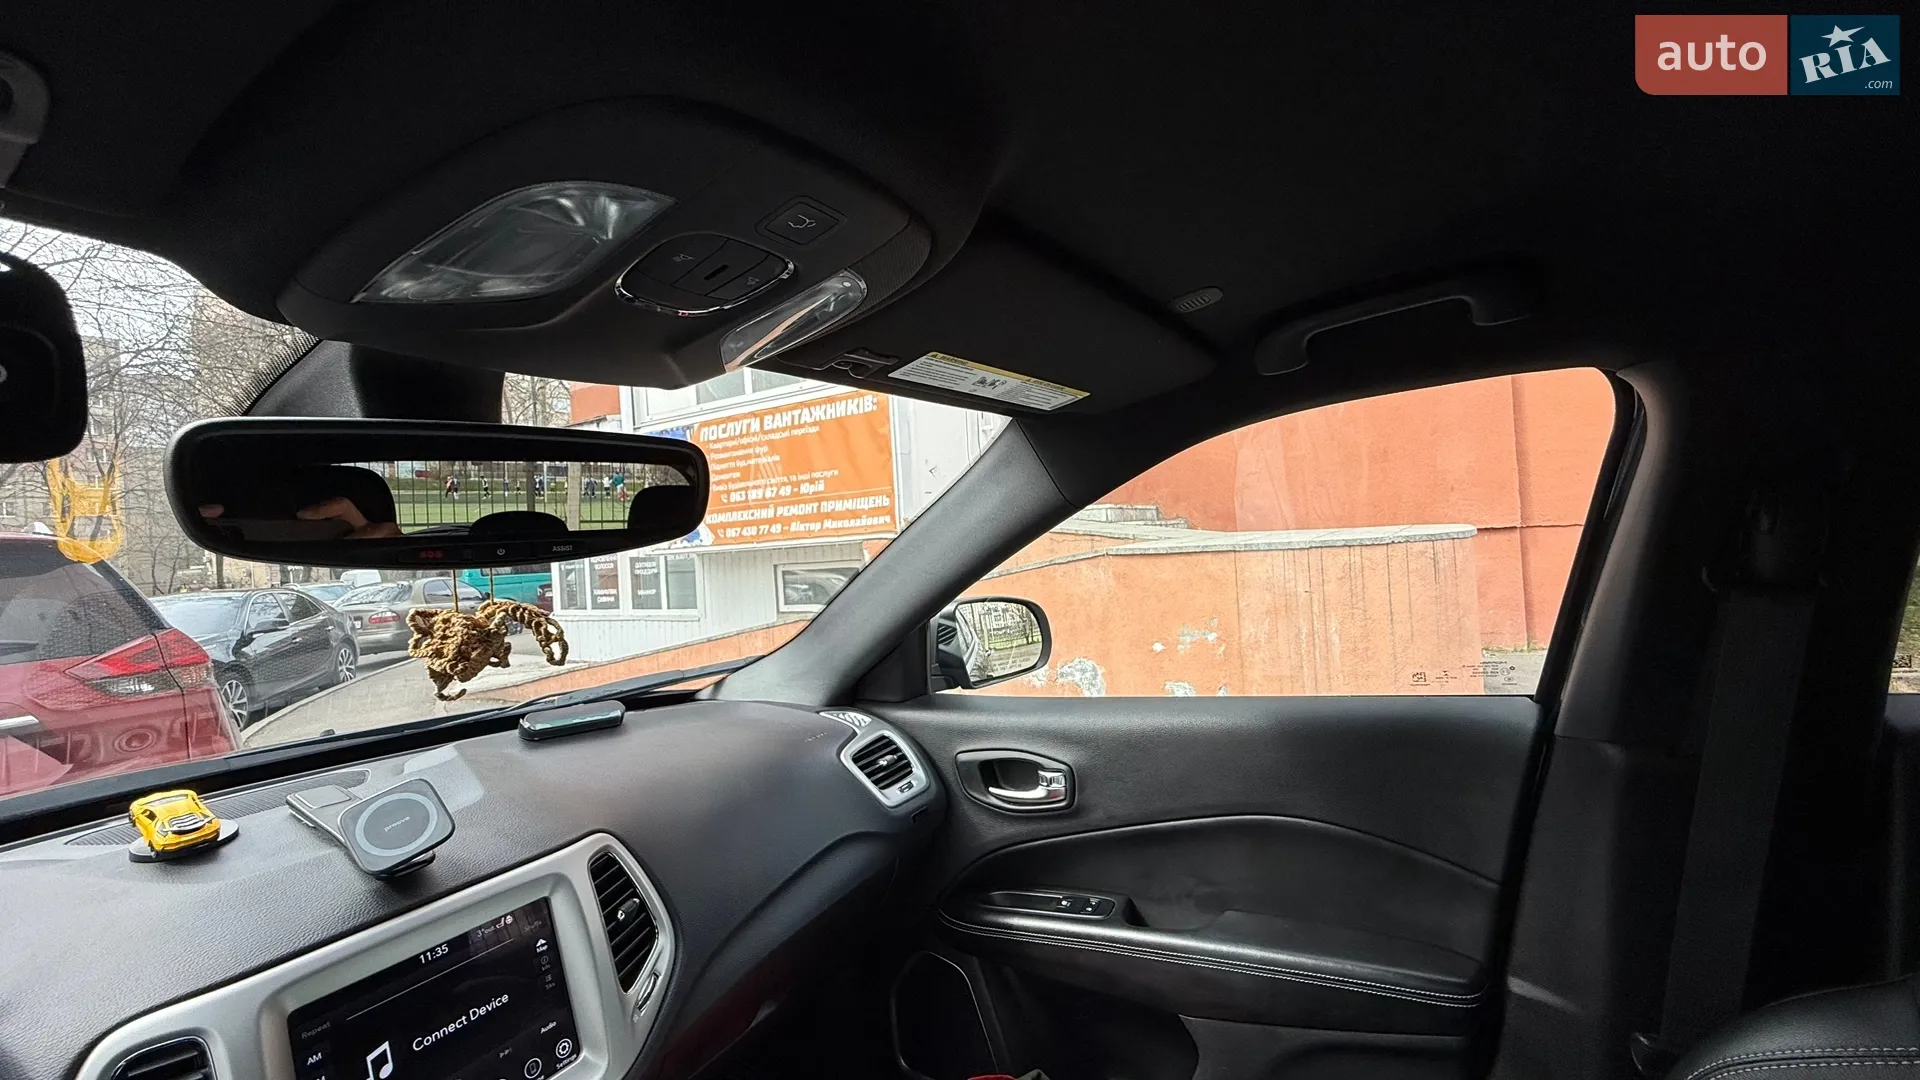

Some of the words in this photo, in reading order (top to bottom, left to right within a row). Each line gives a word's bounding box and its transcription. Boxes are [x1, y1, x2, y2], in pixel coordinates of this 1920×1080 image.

[700, 417, 760, 442] ПОСЛУГИ
[763, 394, 878, 430] ВАНТАЖНИКІВ:
[811, 469, 839, 479] послуги
[730, 490, 746, 502] 063
[747, 489, 763, 500] 189
[764, 487, 778, 499] 67
[779, 485, 792, 496] 49
[800, 480, 825, 494] Юрій
[705, 504, 775, 524] КОМПЛЕКСНИЙ
[776, 502, 819, 517] РЕМОНТ
[820, 495, 890, 512] ПРИМІЩЕНЬ
[725, 527, 741, 538] 067
[759, 525, 770, 535] 77
[770, 523, 782, 534] 49
[790, 521, 822, 532] Віктор
[823, 515, 891, 529] Миколайович
[552, 544, 573, 552] ASSIST
[419, 943, 449, 964] 11:35
[536, 944, 548, 954] Map
[301, 1021, 331, 1039] Repeat
[412, 1015, 468, 1051] Connect
[469, 993, 509, 1021] Device
[540, 1020, 557, 1035] Audio
[307, 1051, 323, 1066] AM
